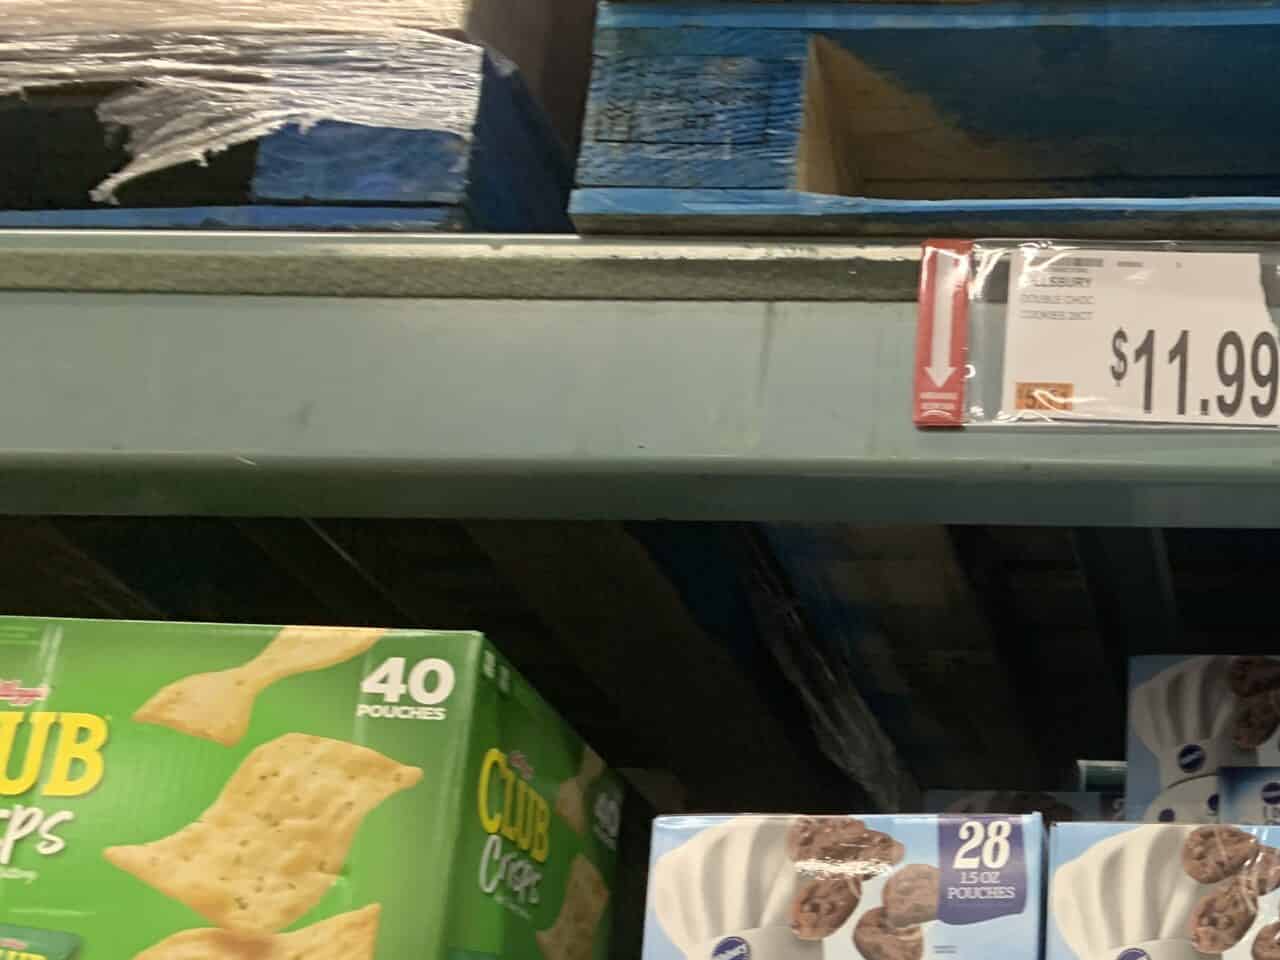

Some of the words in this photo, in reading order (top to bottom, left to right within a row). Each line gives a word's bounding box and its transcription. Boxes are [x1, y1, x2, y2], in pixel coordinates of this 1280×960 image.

[1021, 276, 1092, 289] LLSBURY
[1110, 327, 1279, 418] $11.99
[360, 657, 455, 704] 40
[356, 704, 446, 721] POUCHES
[478, 748, 550, 864] CLUB
[0, 804, 74, 865] ps
[953, 820, 1010, 869] 28
[947, 886, 1015, 900] POUCHES
[981, 872, 1000, 883] OZ
